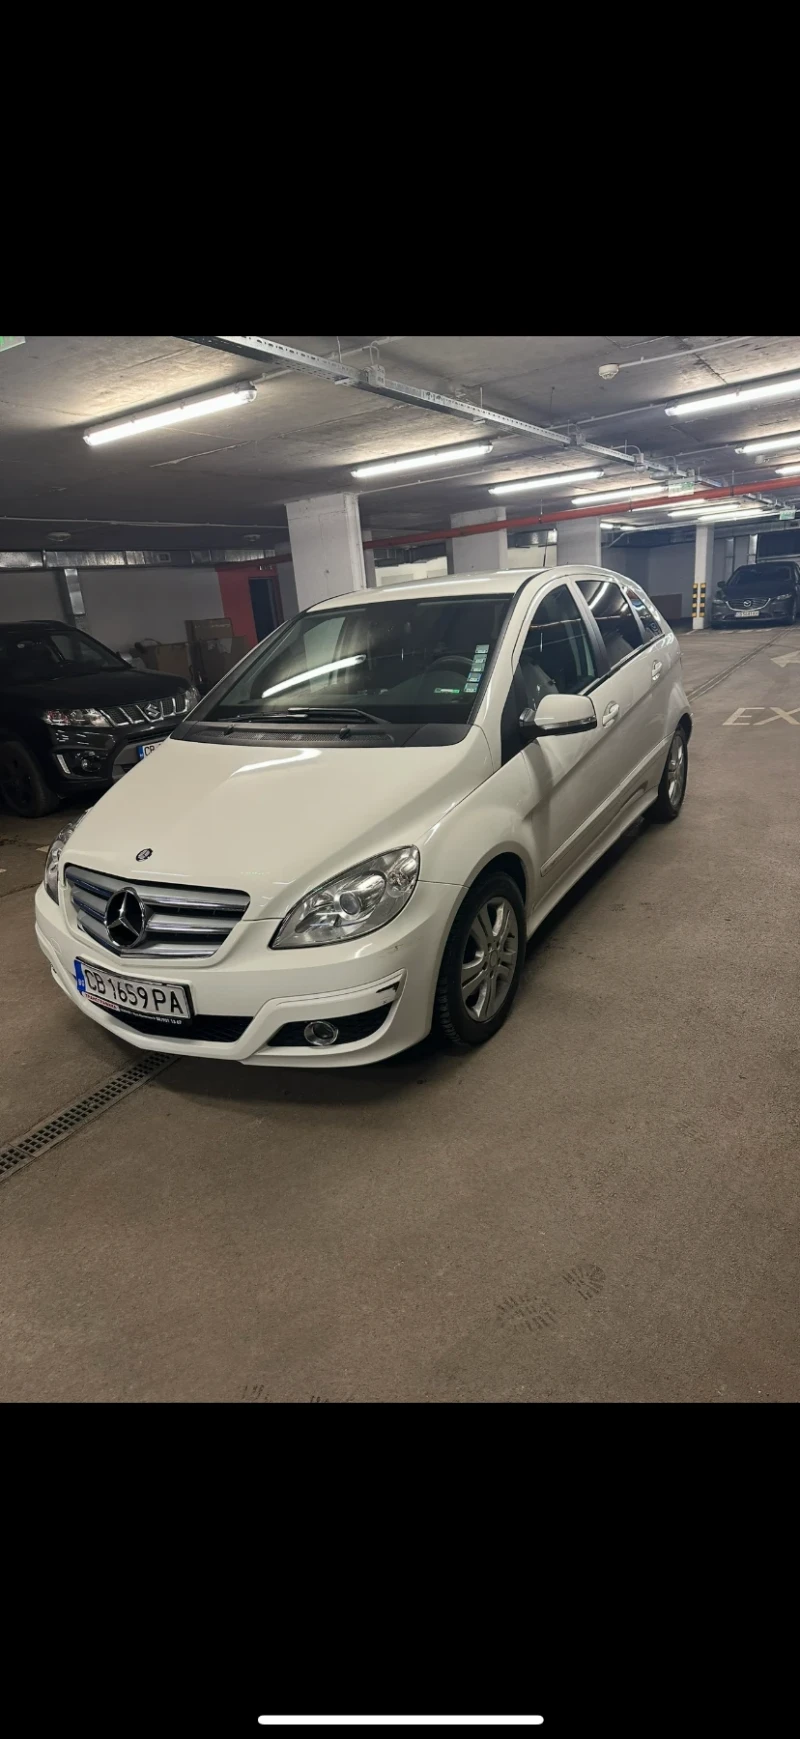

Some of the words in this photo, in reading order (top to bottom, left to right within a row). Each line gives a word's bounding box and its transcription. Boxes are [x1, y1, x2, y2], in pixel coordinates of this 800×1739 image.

[722, 706, 800, 725] EX
[84, 969, 106, 995] CB
[108, 978, 149, 1009] 1659
[152, 988, 184, 1014] PA
